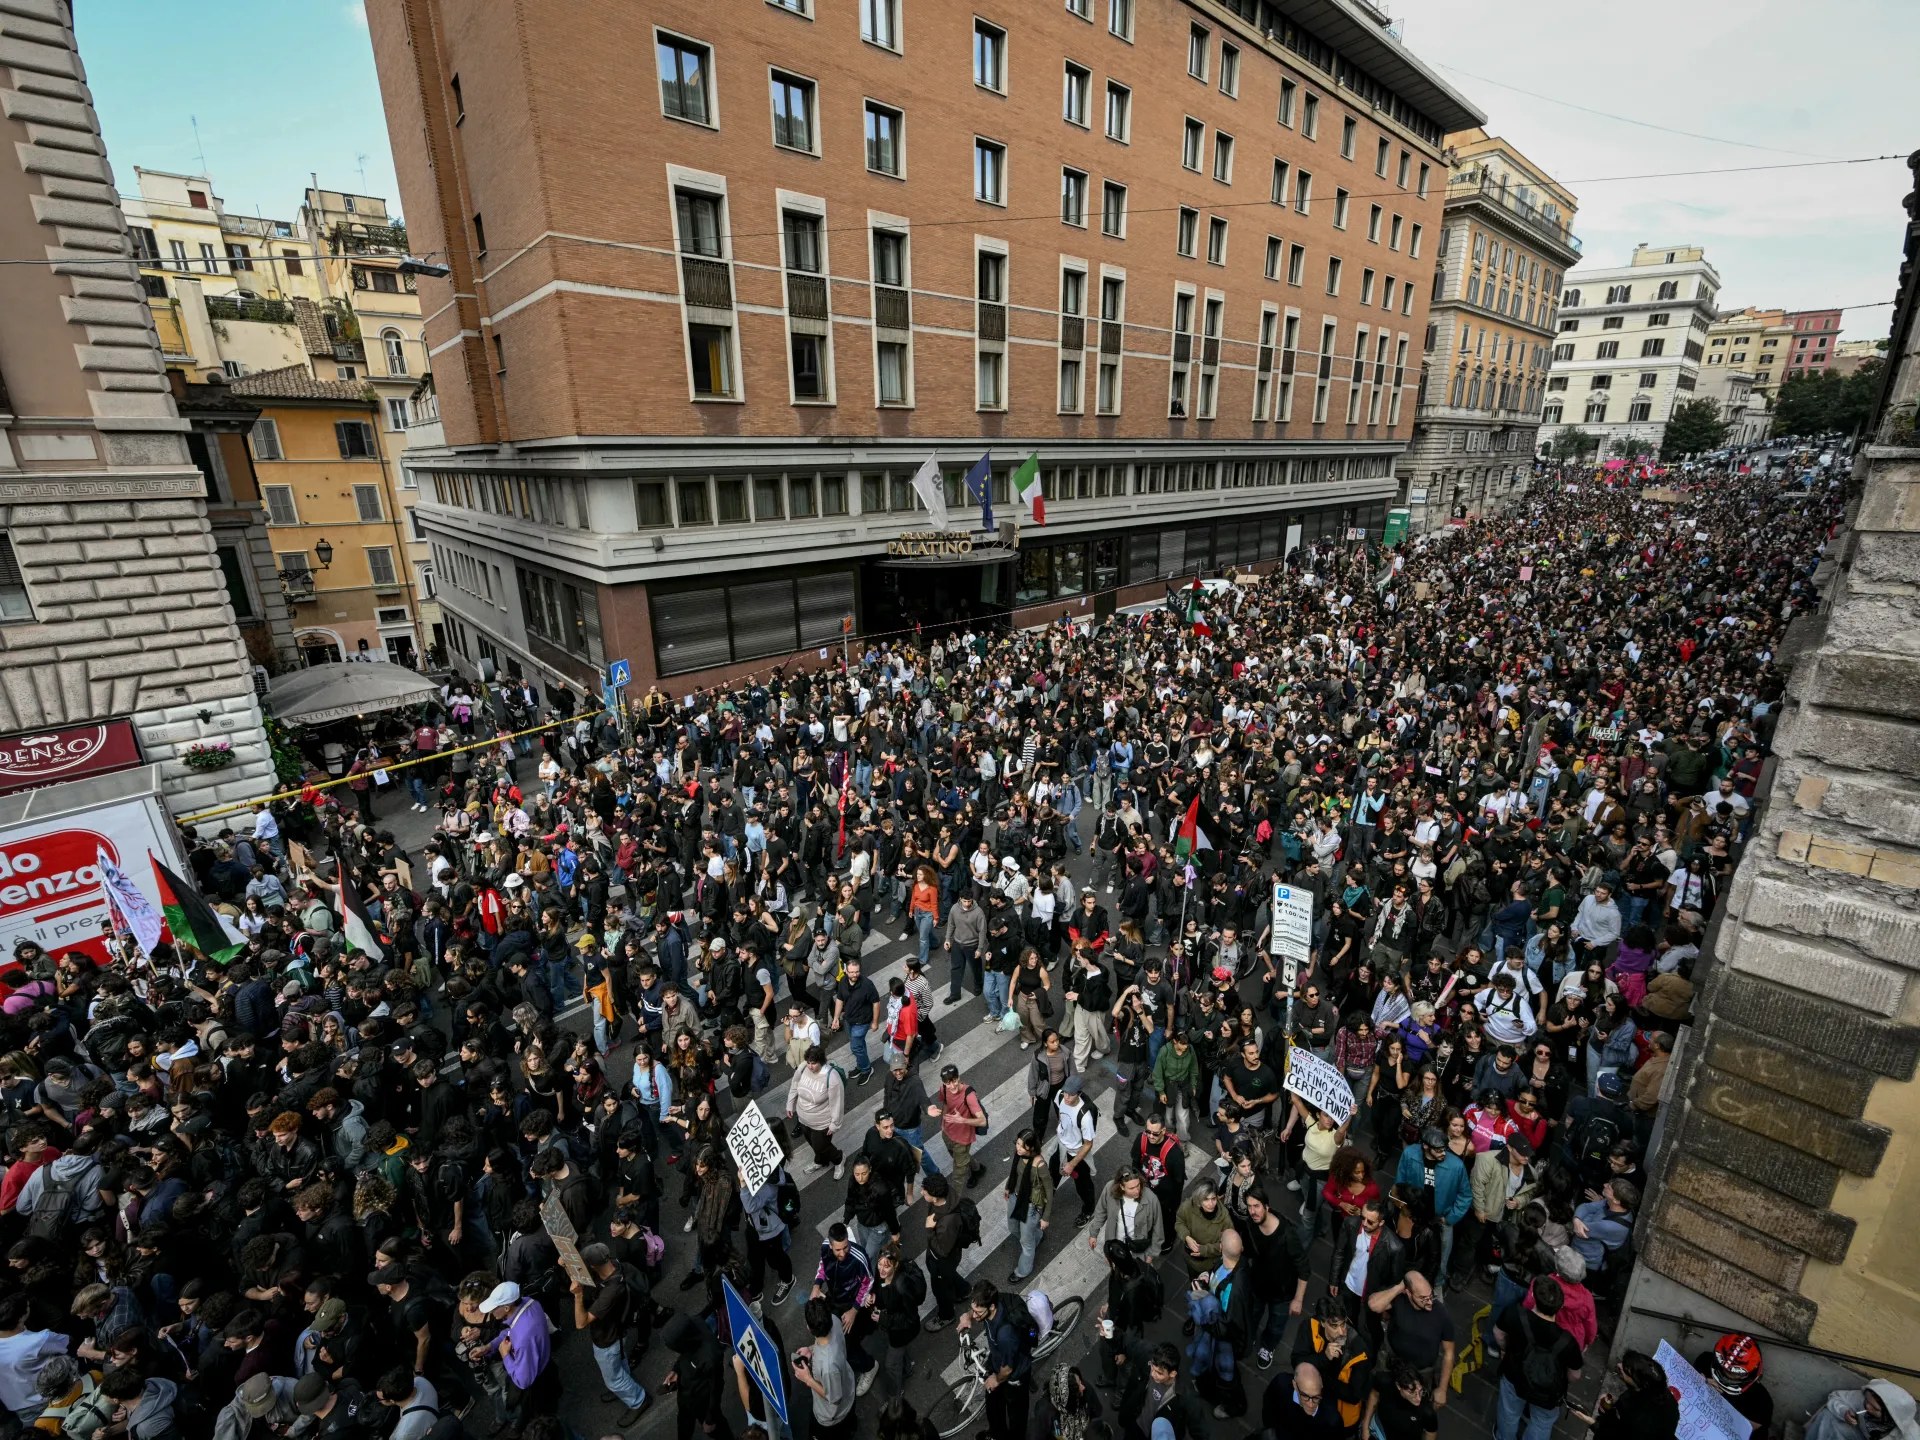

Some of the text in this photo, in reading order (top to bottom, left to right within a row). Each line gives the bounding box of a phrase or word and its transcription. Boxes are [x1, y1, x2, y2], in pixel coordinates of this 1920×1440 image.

[887, 540, 973, 556] PALATINO
[288, 703, 363, 723] RISTORANTE
[378, 692, 428, 708] PIZZERIA
[0, 863, 102, 907] enza
[54, 911, 110, 939] prez
[1287, 1073, 1349, 1122] CERTO PUNTO
[1290, 1062, 1306, 1078] MA
[1307, 1071, 1328, 1092] FINO
[1339, 1093, 1352, 1107] UN
[736, 1116, 772, 1179] LO POSSO
[745, 1107, 779, 1159] NON ME
